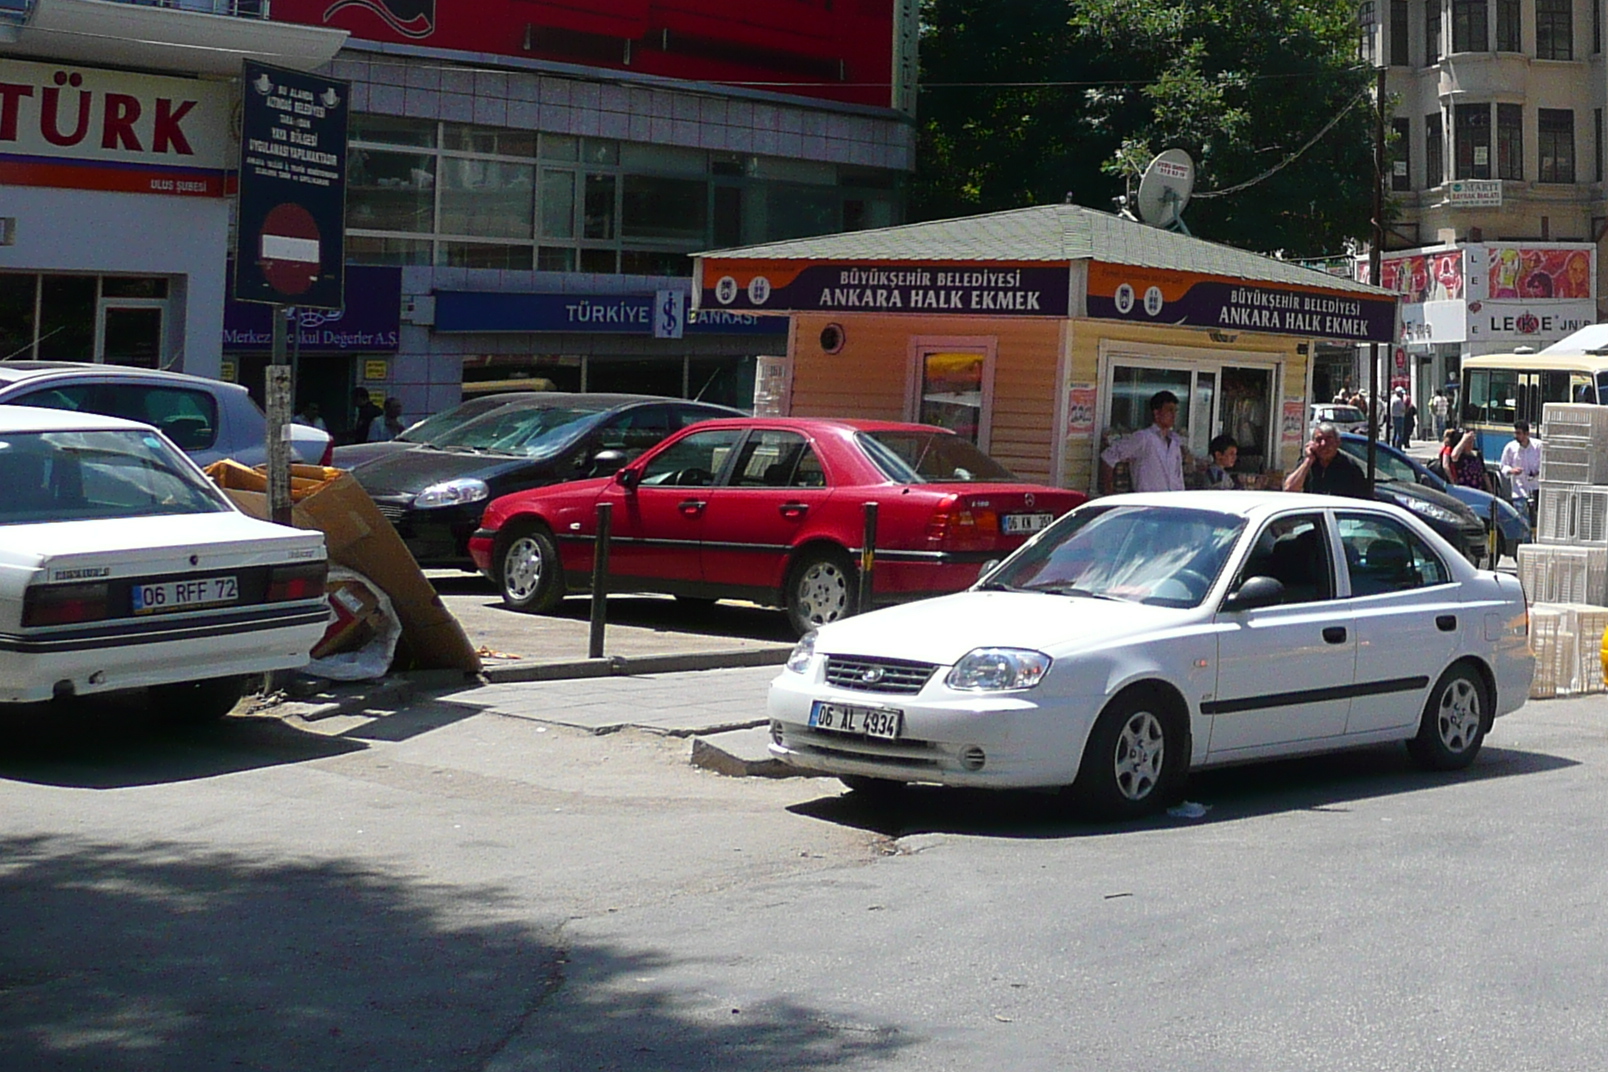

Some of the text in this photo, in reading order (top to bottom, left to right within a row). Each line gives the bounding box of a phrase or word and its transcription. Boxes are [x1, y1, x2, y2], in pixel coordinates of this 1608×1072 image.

[151, 179, 174, 190] ULUS
[840, 268, 1021, 288] BÜYÜKŞEHİR BELEDİYESİ
[819, 288, 1040, 310] ANKARA HALK EKMEK
[1230, 289, 1361, 317] BÜYÜKŞEHİR BELEDİYESİ
[565, 300, 650, 323] TÜRKİYE
[1218, 306, 1369, 336] ANKARA HALK EKMEK
[224, 329, 271, 344] Merkez
[323, 329, 373, 348] Değerler
[143, 579, 237, 606] 06 RFF 72
[818, 705, 895, 737] 06 AL 4934
